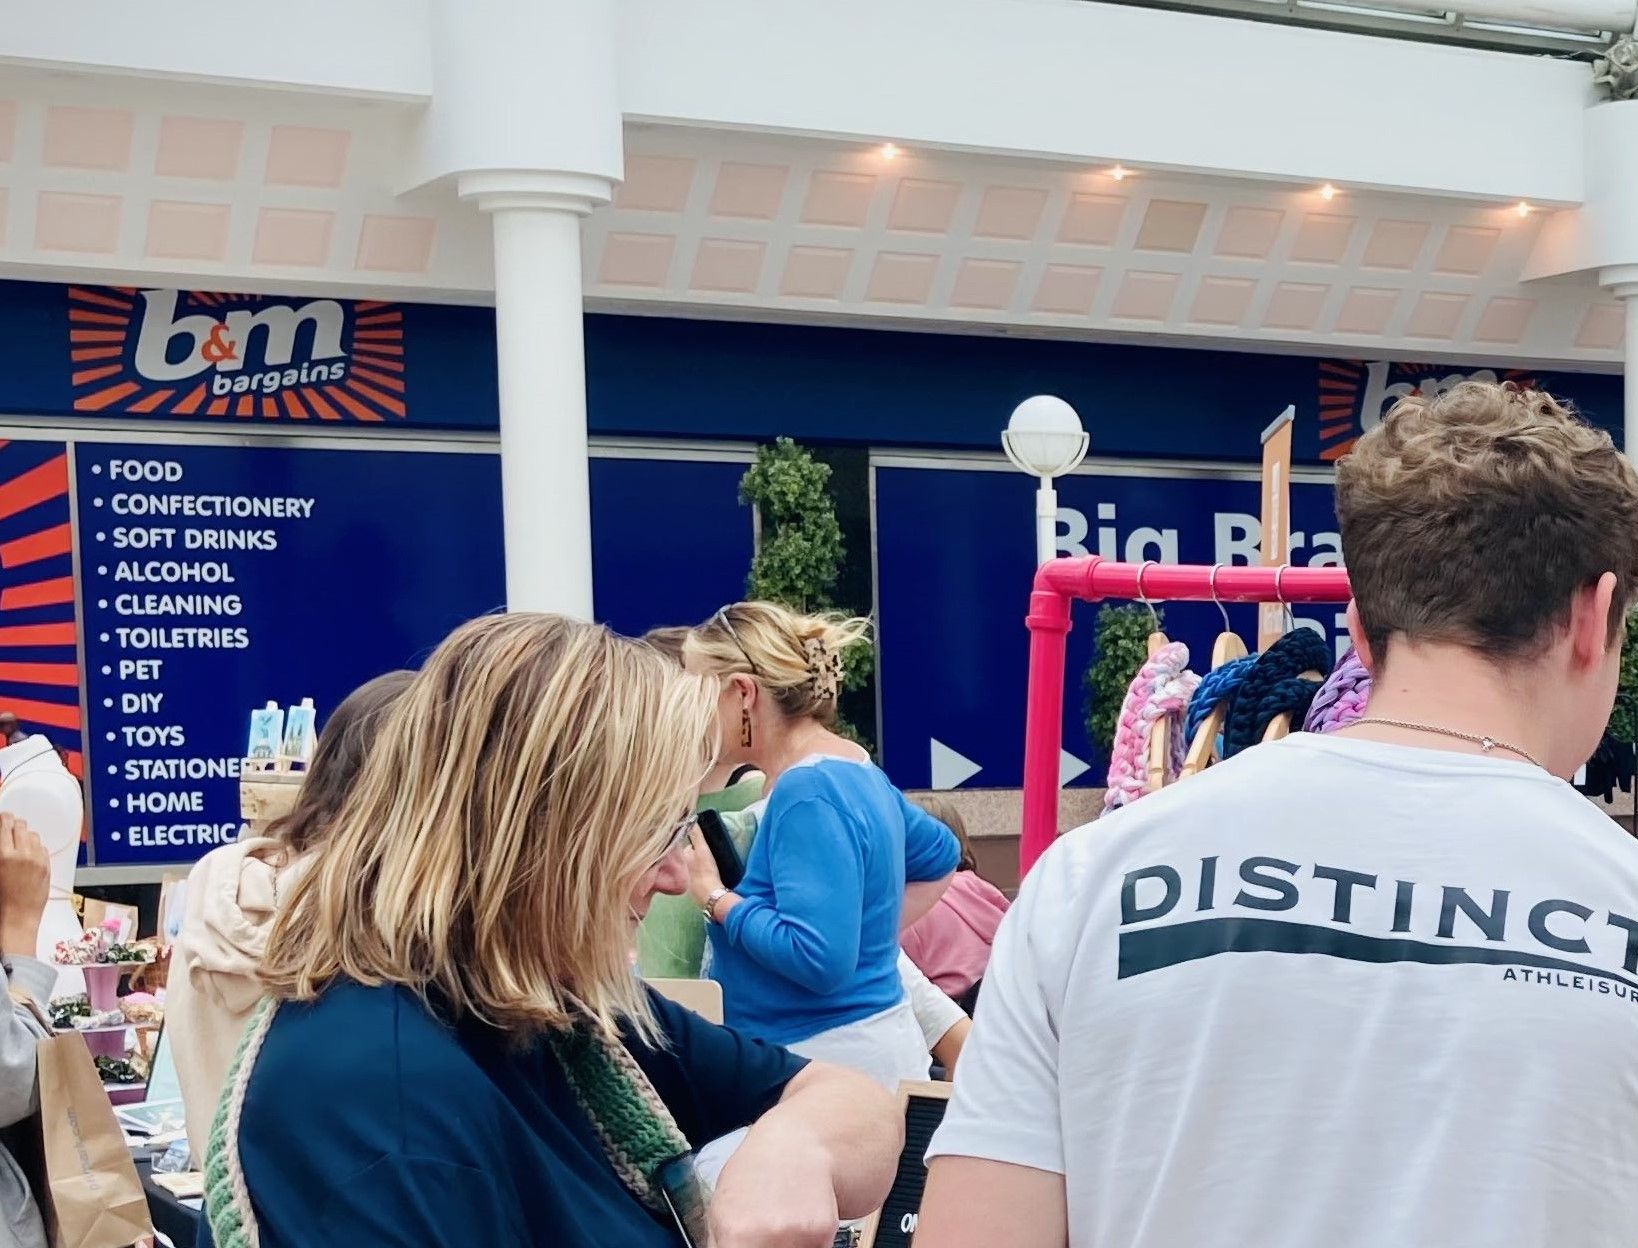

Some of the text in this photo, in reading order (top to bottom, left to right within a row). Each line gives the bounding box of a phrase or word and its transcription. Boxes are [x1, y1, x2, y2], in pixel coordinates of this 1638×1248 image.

[134, 289, 348, 381] b&m
[212, 362, 345, 396] bargains
[110, 460, 183, 482] FOOD
[111, 494, 315, 518] CONFECTIONERY
[112, 528, 278, 551] SOFT DRINKS
[114, 560, 235, 583] ALCOHOL
[114, 594, 242, 616] CLEANING
[116, 628, 250, 650] TOILETRIES
[119, 659, 163, 682] PET
[121, 693, 164, 715] DIY
[122, 725, 185, 748] TOYS
[126, 791, 204, 813] HOME
